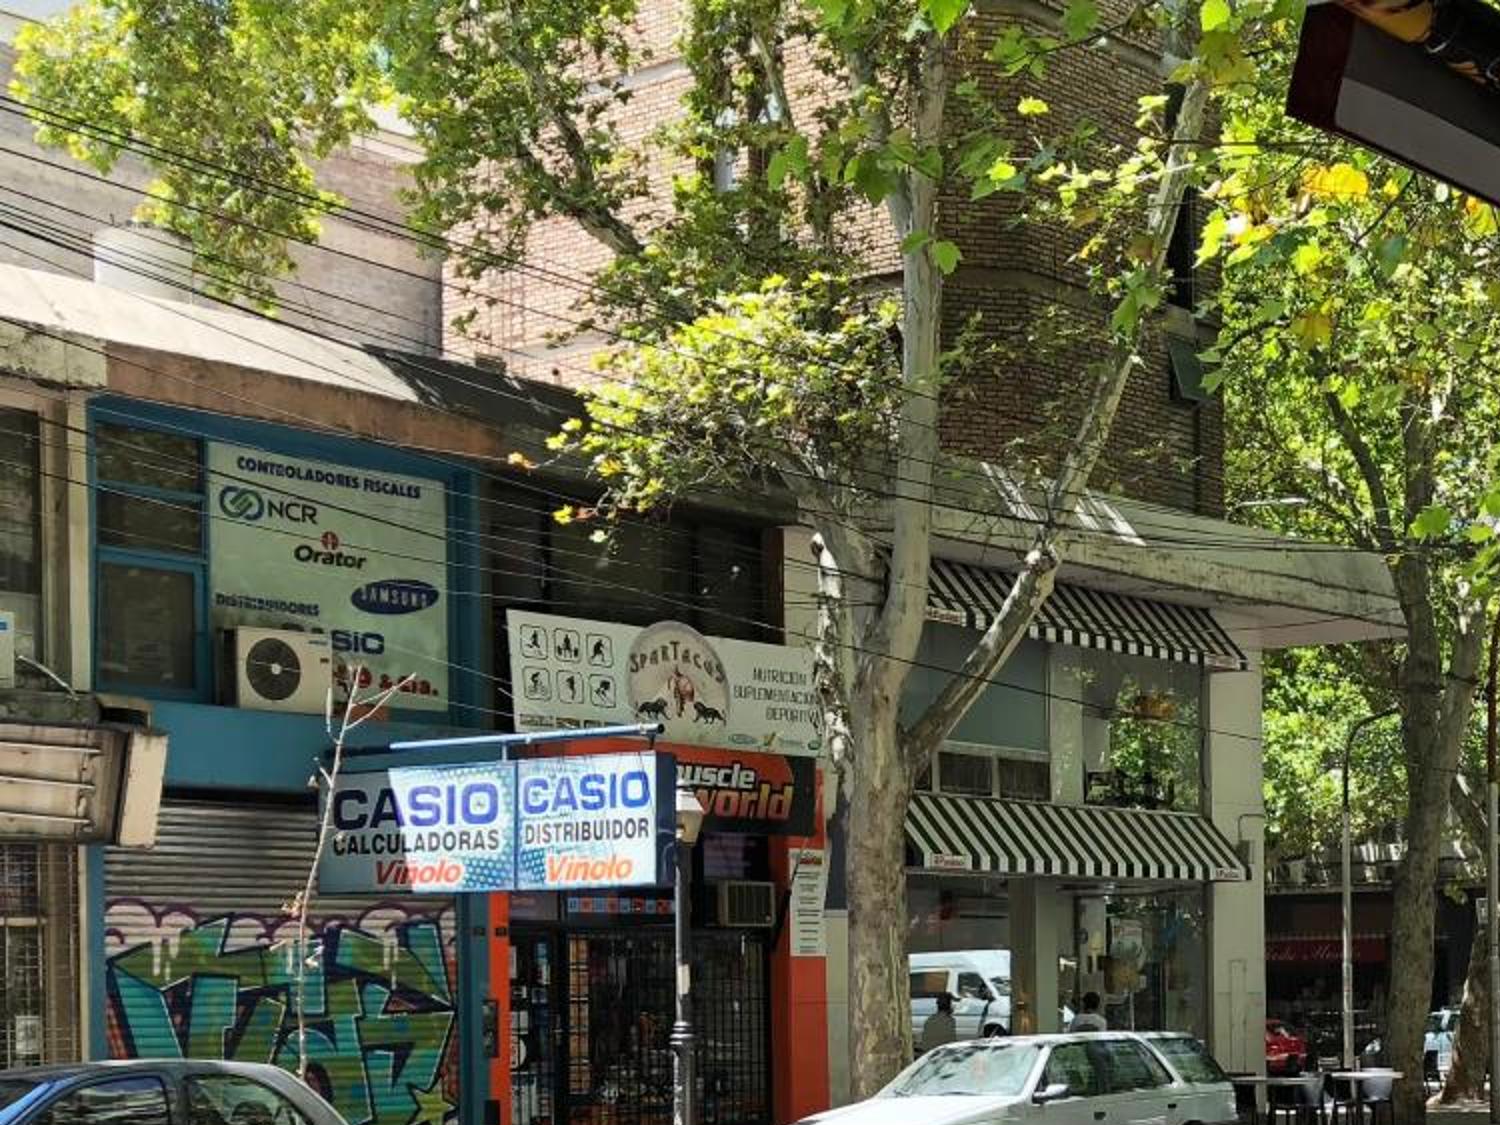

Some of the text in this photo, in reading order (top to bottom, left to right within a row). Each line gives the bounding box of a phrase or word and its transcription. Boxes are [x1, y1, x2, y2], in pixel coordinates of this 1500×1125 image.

[237, 455, 421, 499] CONTROLADORES FISCALES
[267, 501, 318, 525] NCR
[293, 544, 367, 570] Orator
[629, 640, 726, 683] SPARTACUS
[333, 770, 651, 831] CASIO CASIO
[333, 816, 650, 857] CALCULADORAS DISTRIBUIDOR
